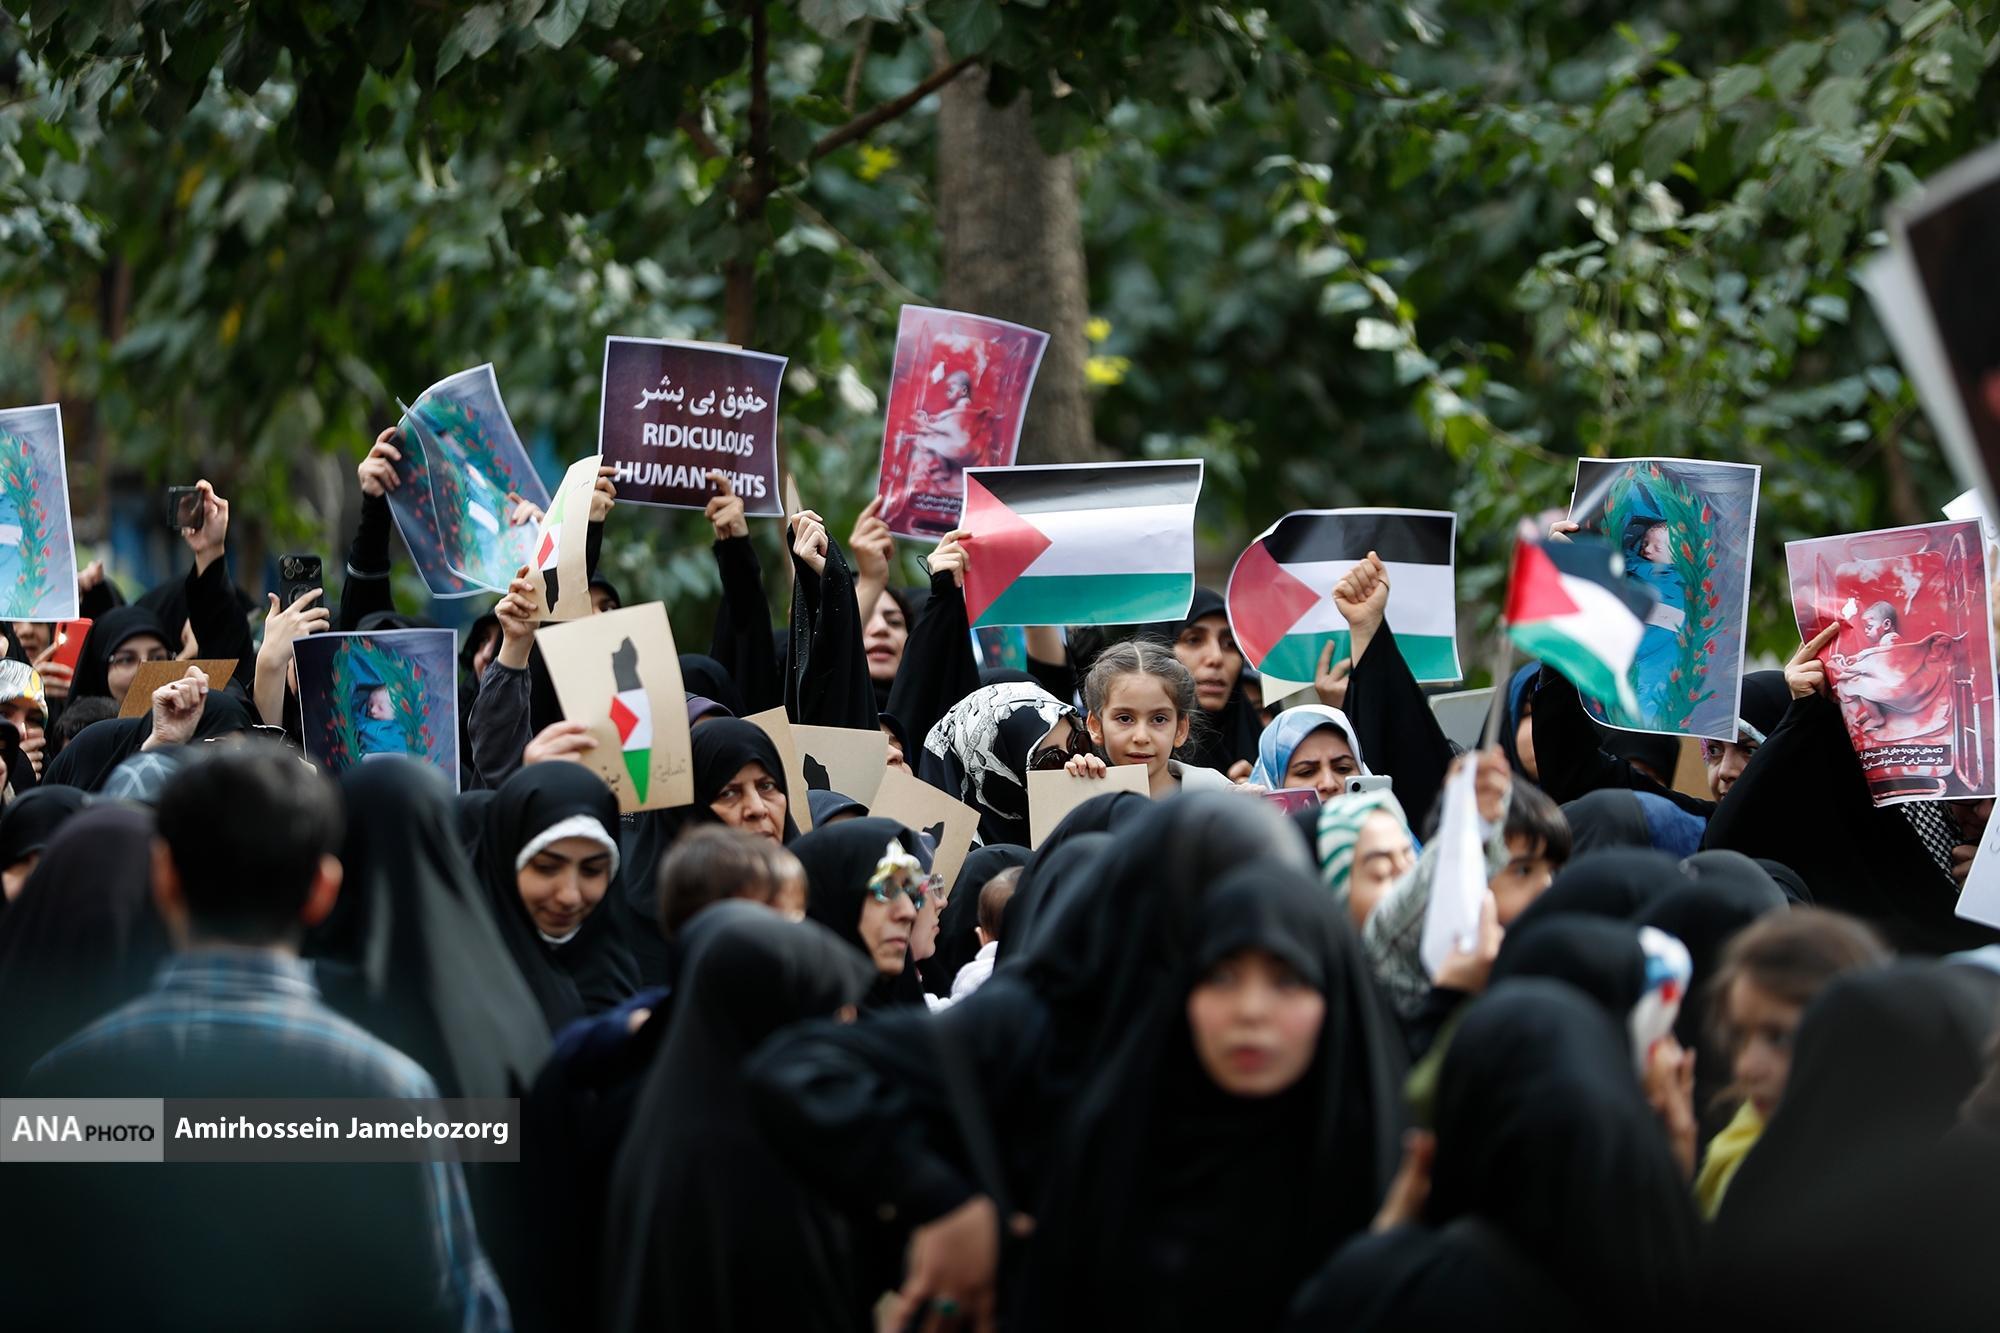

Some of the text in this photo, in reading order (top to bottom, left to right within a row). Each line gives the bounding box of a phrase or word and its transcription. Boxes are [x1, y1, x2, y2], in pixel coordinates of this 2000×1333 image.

[634, 375, 768, 419] حقوق بی بشر
[642, 423, 755, 457] RIDICULOUS
[613, 460, 706, 490] HUMAN
